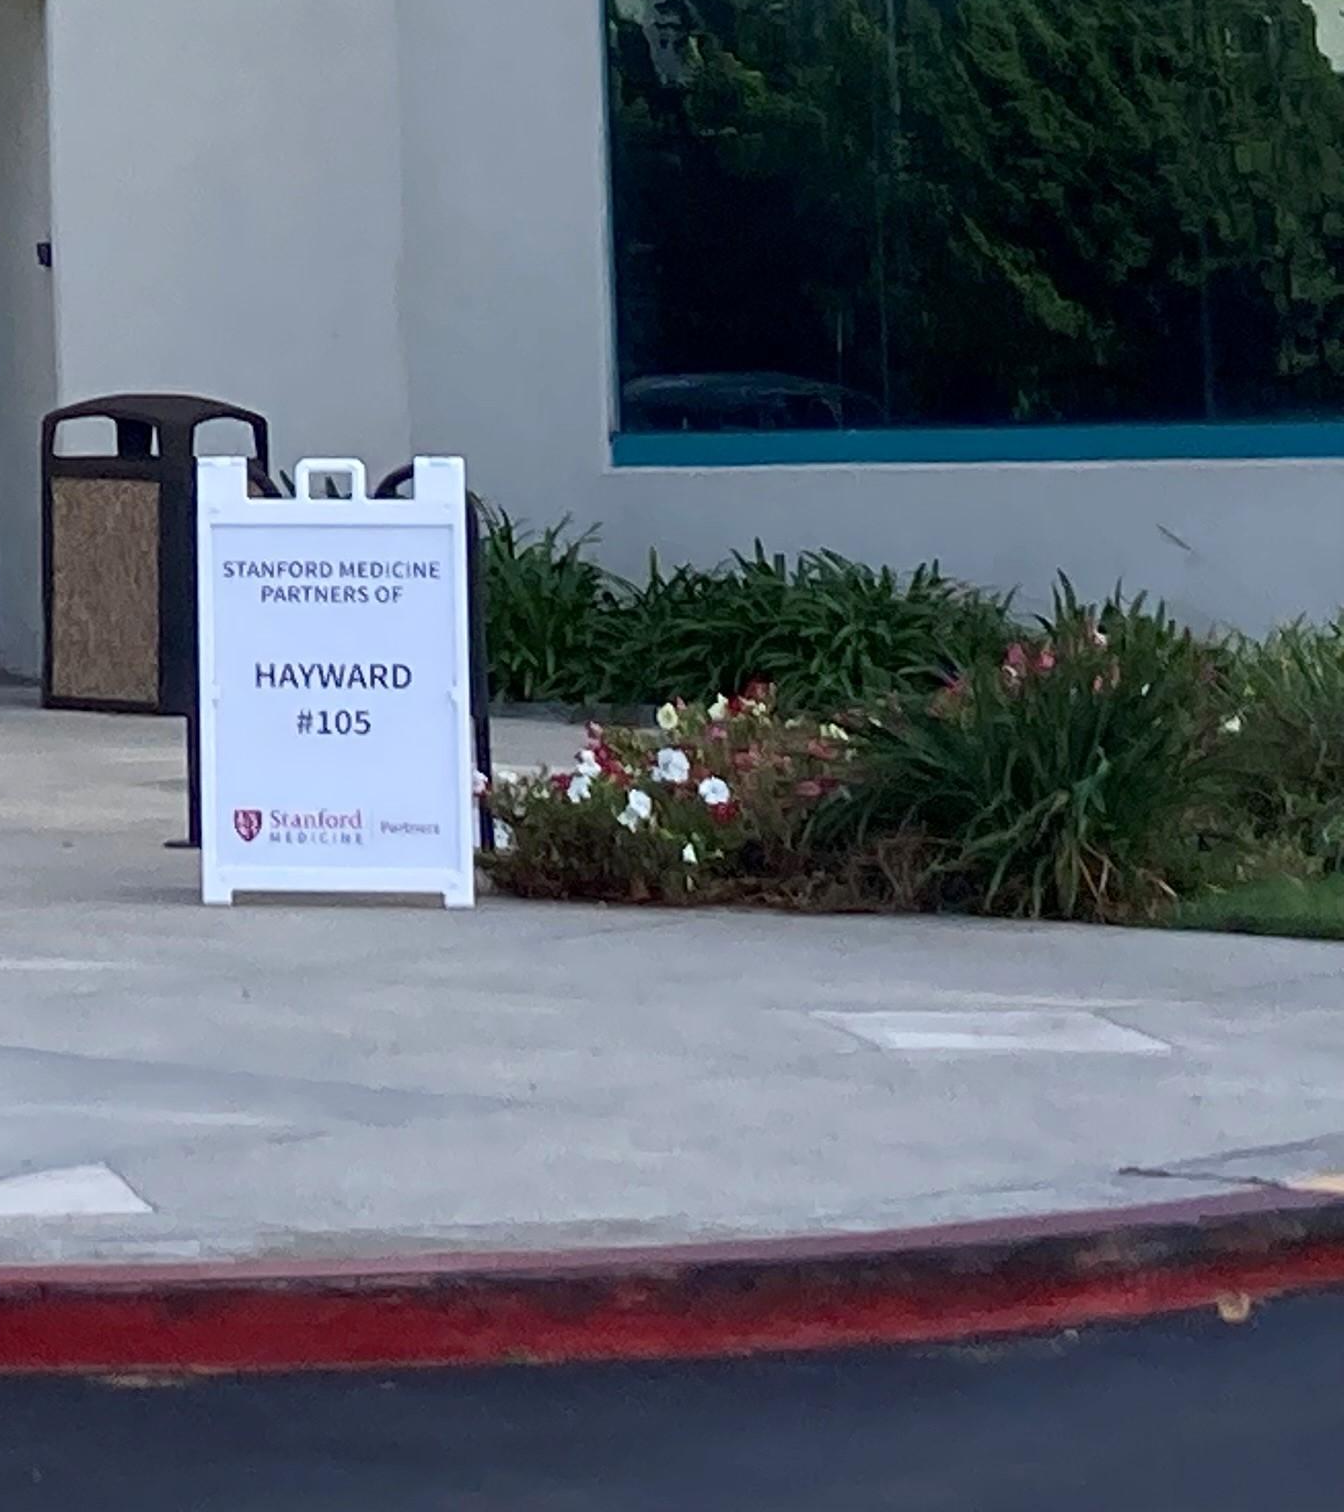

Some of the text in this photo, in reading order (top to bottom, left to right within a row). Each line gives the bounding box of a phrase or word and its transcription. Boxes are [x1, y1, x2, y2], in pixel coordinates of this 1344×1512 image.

[223, 560, 441, 579] STANFORD MEDICINE
[261, 584, 404, 604] PARTNERS OF
[254, 662, 413, 690] HAYWARD
[296, 709, 372, 736] #105
[269, 808, 363, 830] Stanford
[268, 831, 364, 846] MEDICINE
